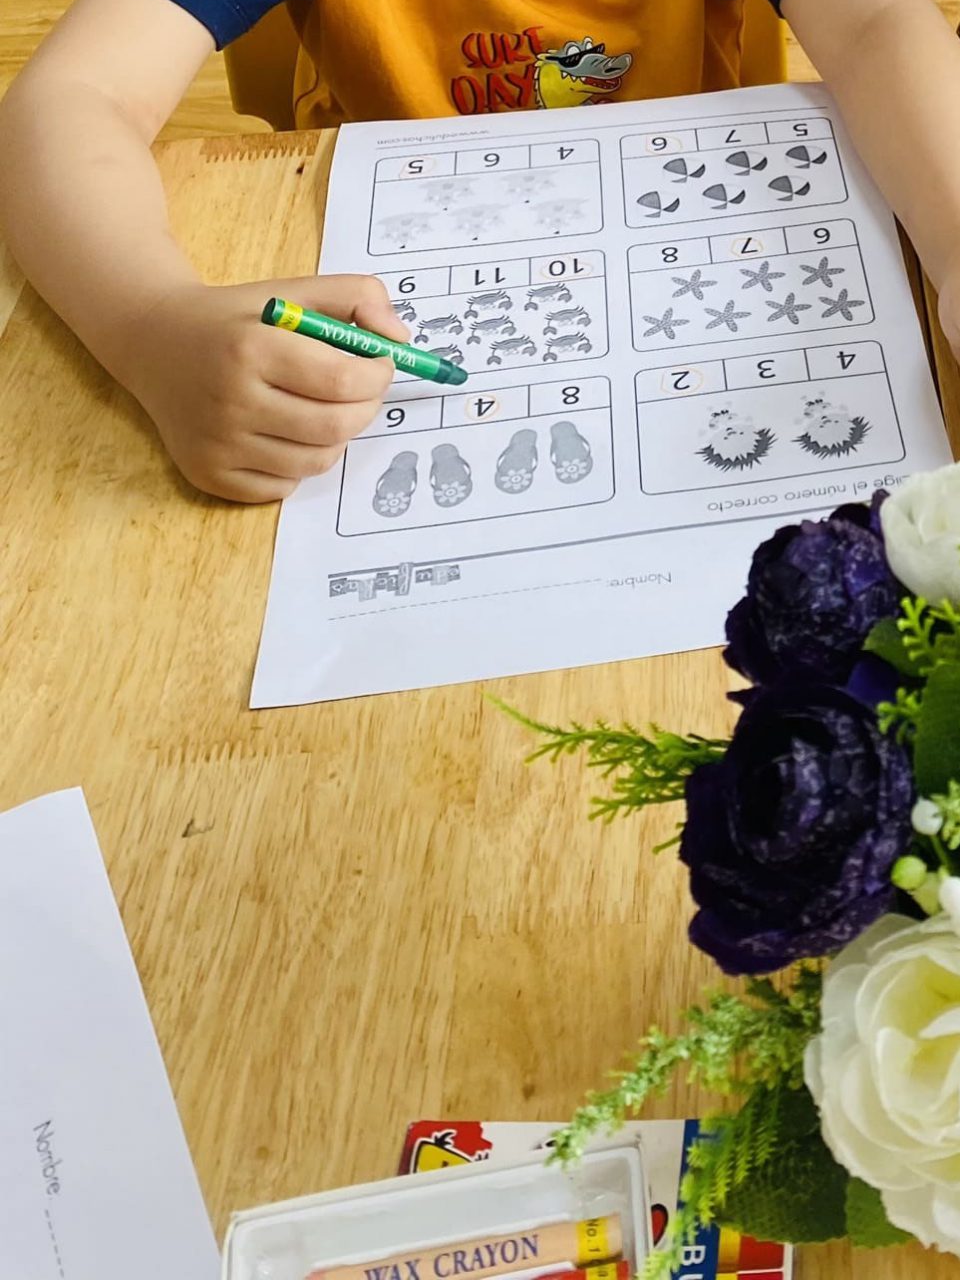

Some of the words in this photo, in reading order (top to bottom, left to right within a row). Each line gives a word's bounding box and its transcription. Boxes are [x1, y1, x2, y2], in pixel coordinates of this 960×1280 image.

[451, 65, 538, 116] DAY
[725, 124, 744, 143] 7
[793, 121, 808, 136] 5
[652, 137, 667, 152] 6
[484, 153, 500, 168] 6
[558, 147, 574, 161] 4
[408, 160, 423, 175] 5
[814, 228, 830, 245] 6
[662, 247, 678, 263] 8
[741, 238, 758, 254] 7
[549, 258, 583, 276] 10
[399, 277, 416, 293] 9
[475, 268, 505, 287] 11
[321, 322, 382, 354] CRAYON
[757, 360, 775, 378] 3
[837, 351, 855, 369] 4
[671, 371, 690, 390] 2
[562, 387, 579, 405] 8
[475, 398, 495, 417] 4
[387, 408, 405, 428] 6
[784, 484, 847, 502] número
[853, 480, 868, 496] el
[707, 493, 779, 512] correcto
[432, 1234, 539, 1279] CRAYON
